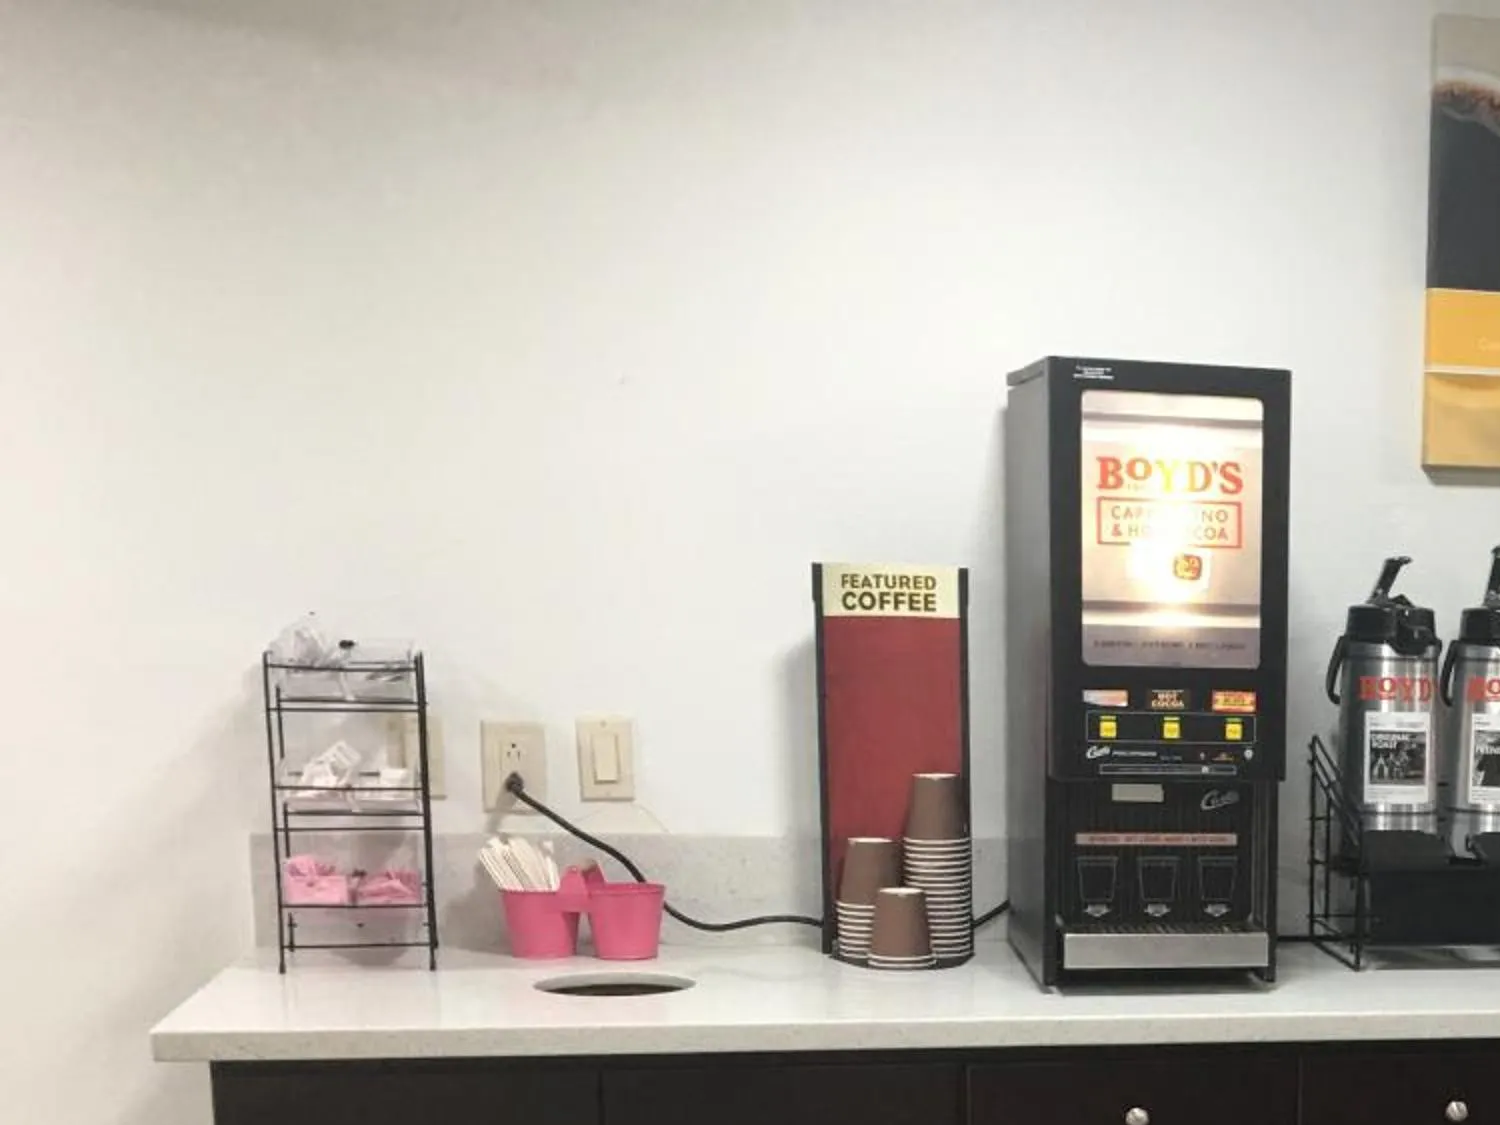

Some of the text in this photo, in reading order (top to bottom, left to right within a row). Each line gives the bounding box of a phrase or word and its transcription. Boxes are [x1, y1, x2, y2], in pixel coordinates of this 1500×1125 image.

[1096, 456, 1244, 495] BOYD'S
[841, 573, 937, 591] FEATURED
[841, 591, 938, 613] COFFEE
